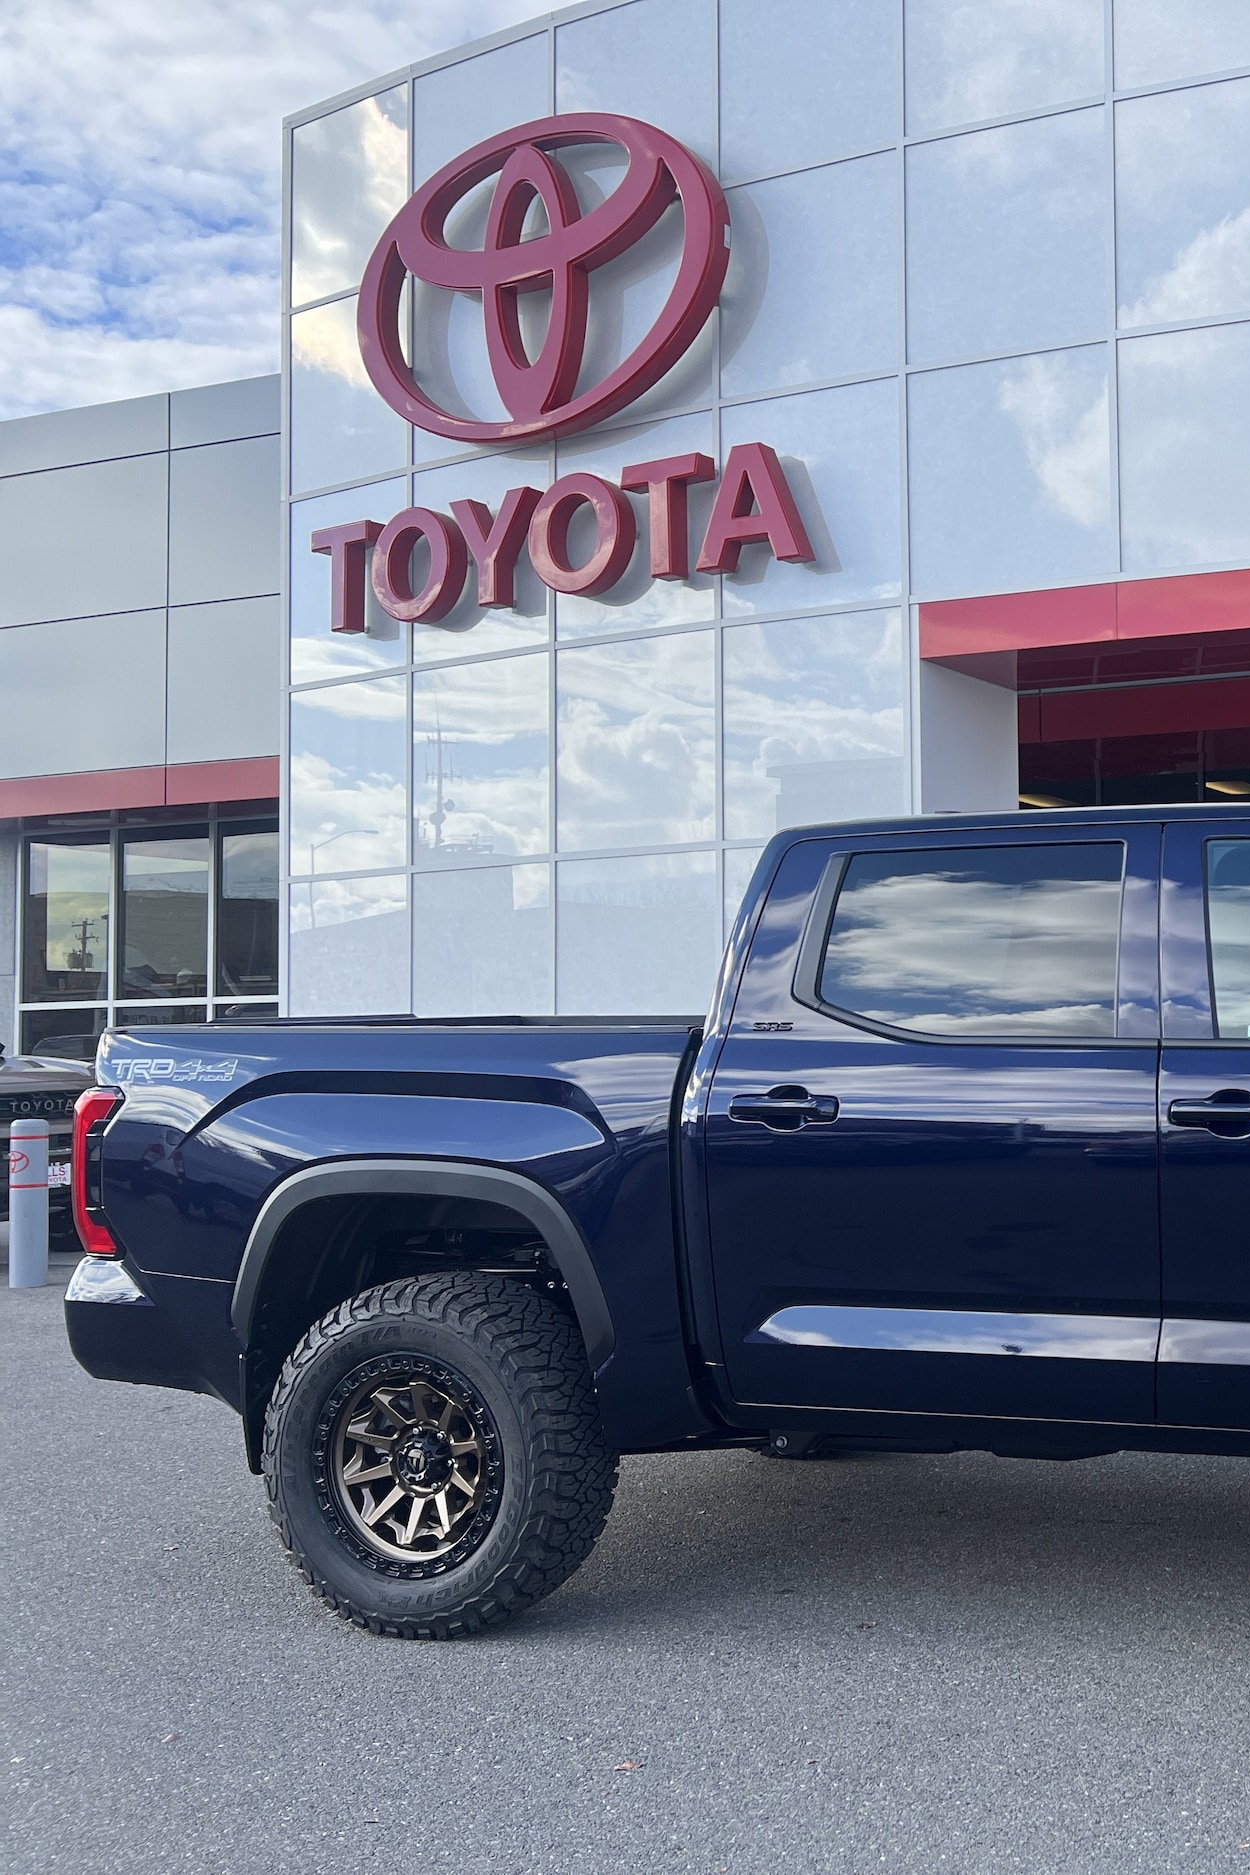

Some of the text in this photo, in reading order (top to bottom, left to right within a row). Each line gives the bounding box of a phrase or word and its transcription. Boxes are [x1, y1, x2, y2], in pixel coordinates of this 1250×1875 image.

[311, 442, 816, 635] TOYOTA
[111, 1059, 176, 1083] TRD
[172, 1074, 233, 1082] OFF ROAD
[10, 1099, 74, 1113] TOYOTA
